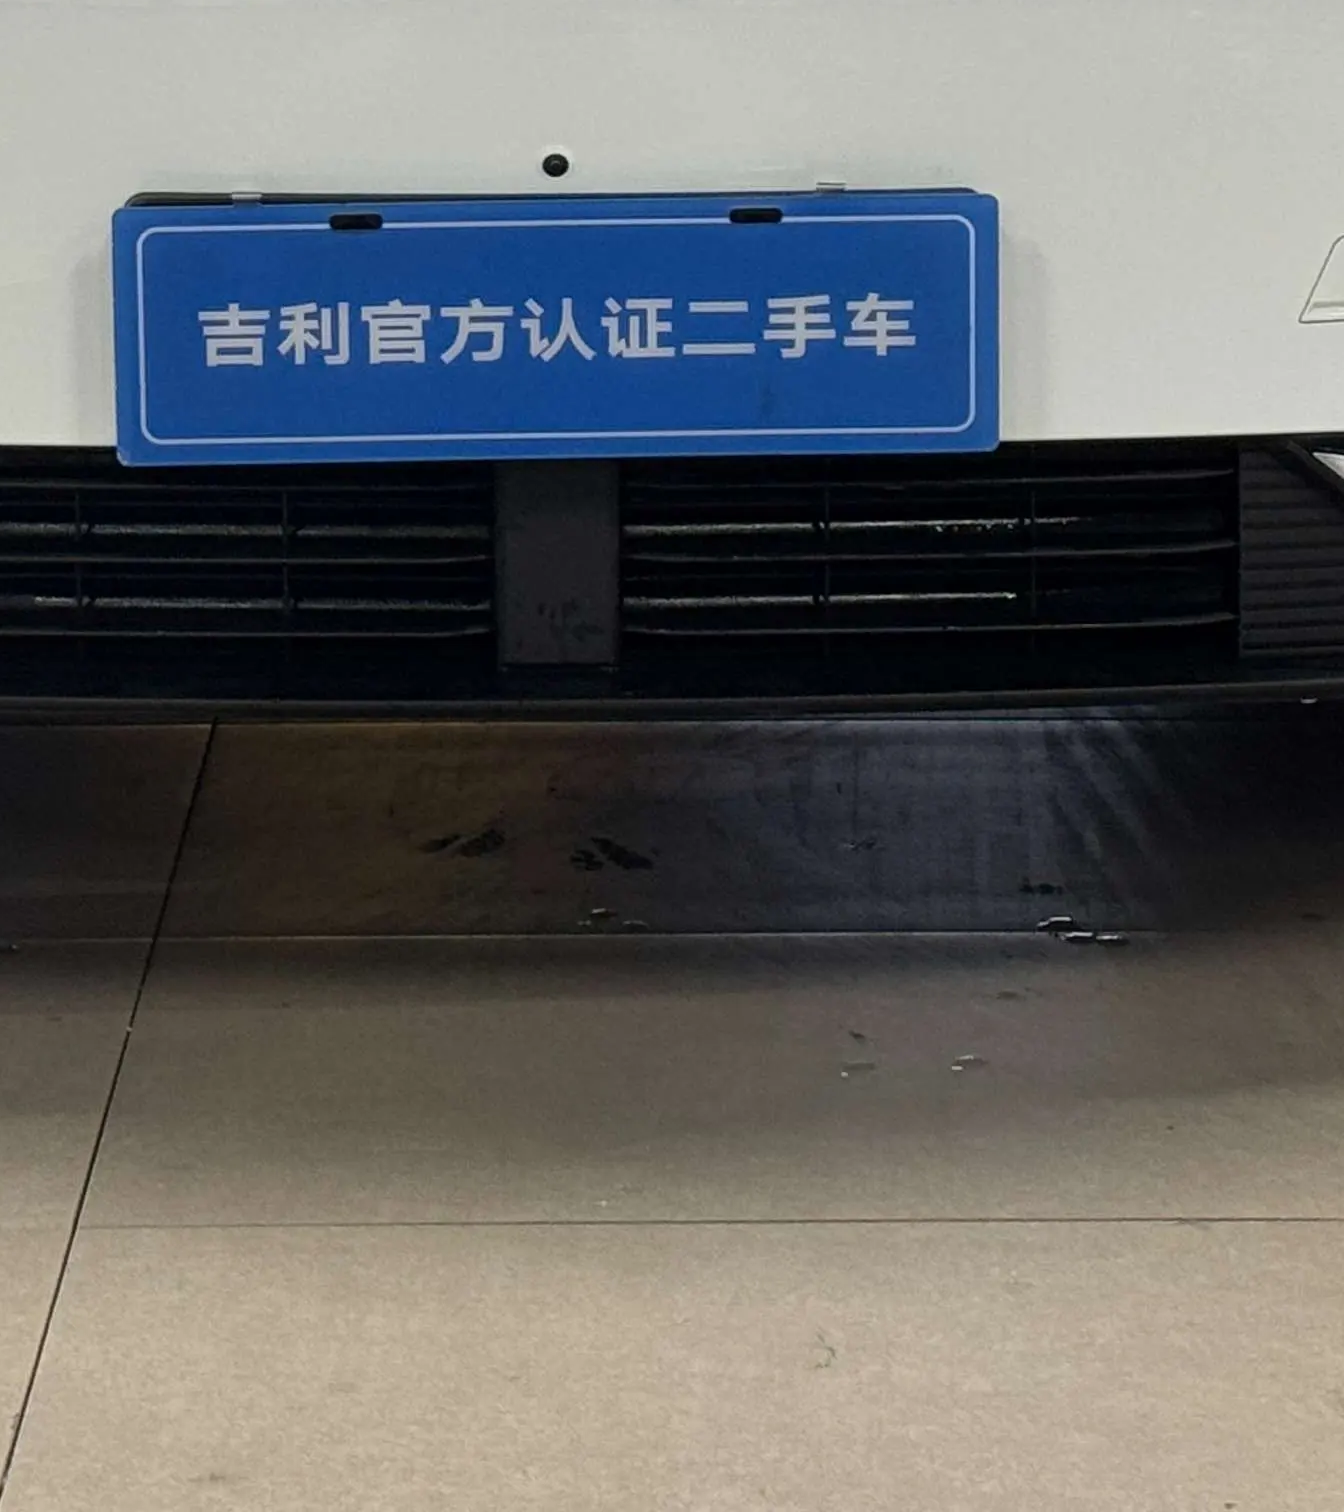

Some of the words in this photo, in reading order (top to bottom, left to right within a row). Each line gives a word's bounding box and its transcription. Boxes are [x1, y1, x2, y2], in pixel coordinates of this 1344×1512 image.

[197, 292, 918, 367] 吉利官方认证二手车
